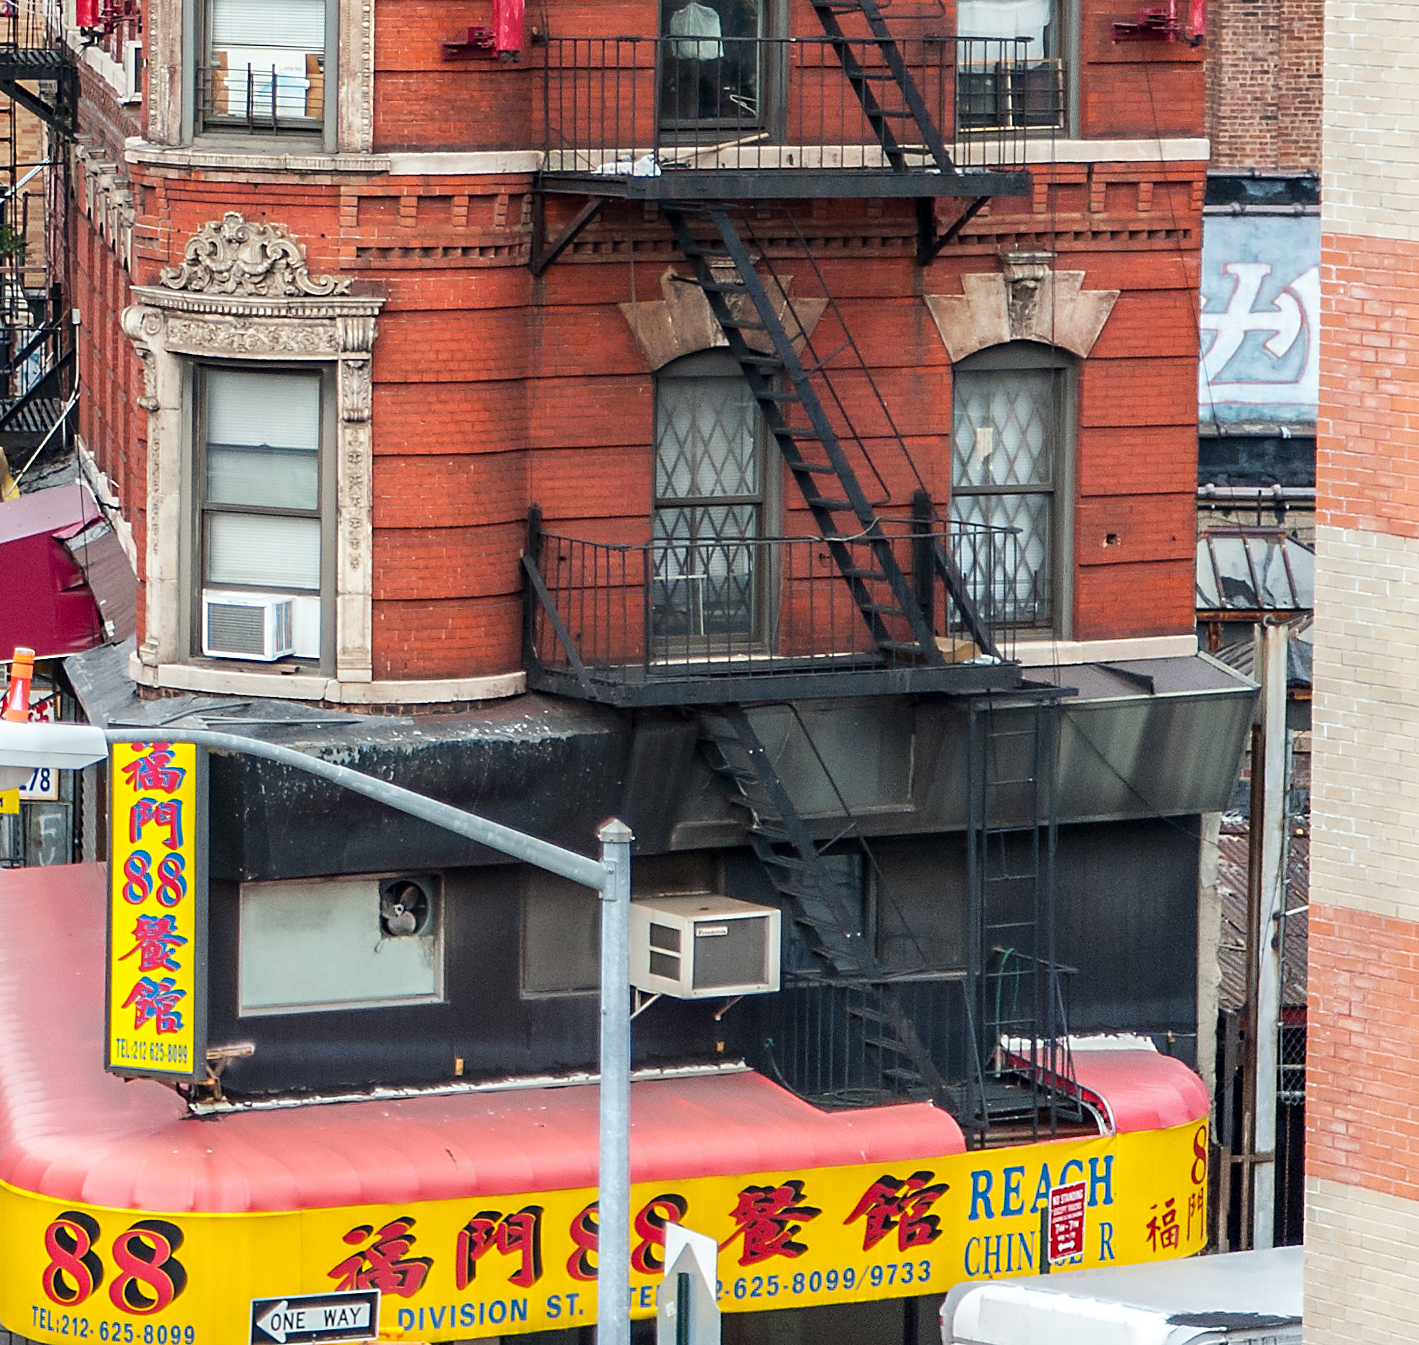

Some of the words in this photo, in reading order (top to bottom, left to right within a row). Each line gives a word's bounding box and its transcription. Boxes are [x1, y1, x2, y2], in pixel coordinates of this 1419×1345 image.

[19, 768, 50, 792] 78
[1053, 1195, 1060, 1205] NO
[1061, 1189, 1083, 1204] STANDING
[41, 1211, 188, 1317] 88
[270, 1308, 306, 1331] ONE
[323, 1307, 362, 1328] WAY
[397, 1297, 529, 1332] DIVISION
[546, 1292, 585, 1319] ST.
[99, 1322, 196, 1345] 625-8099
